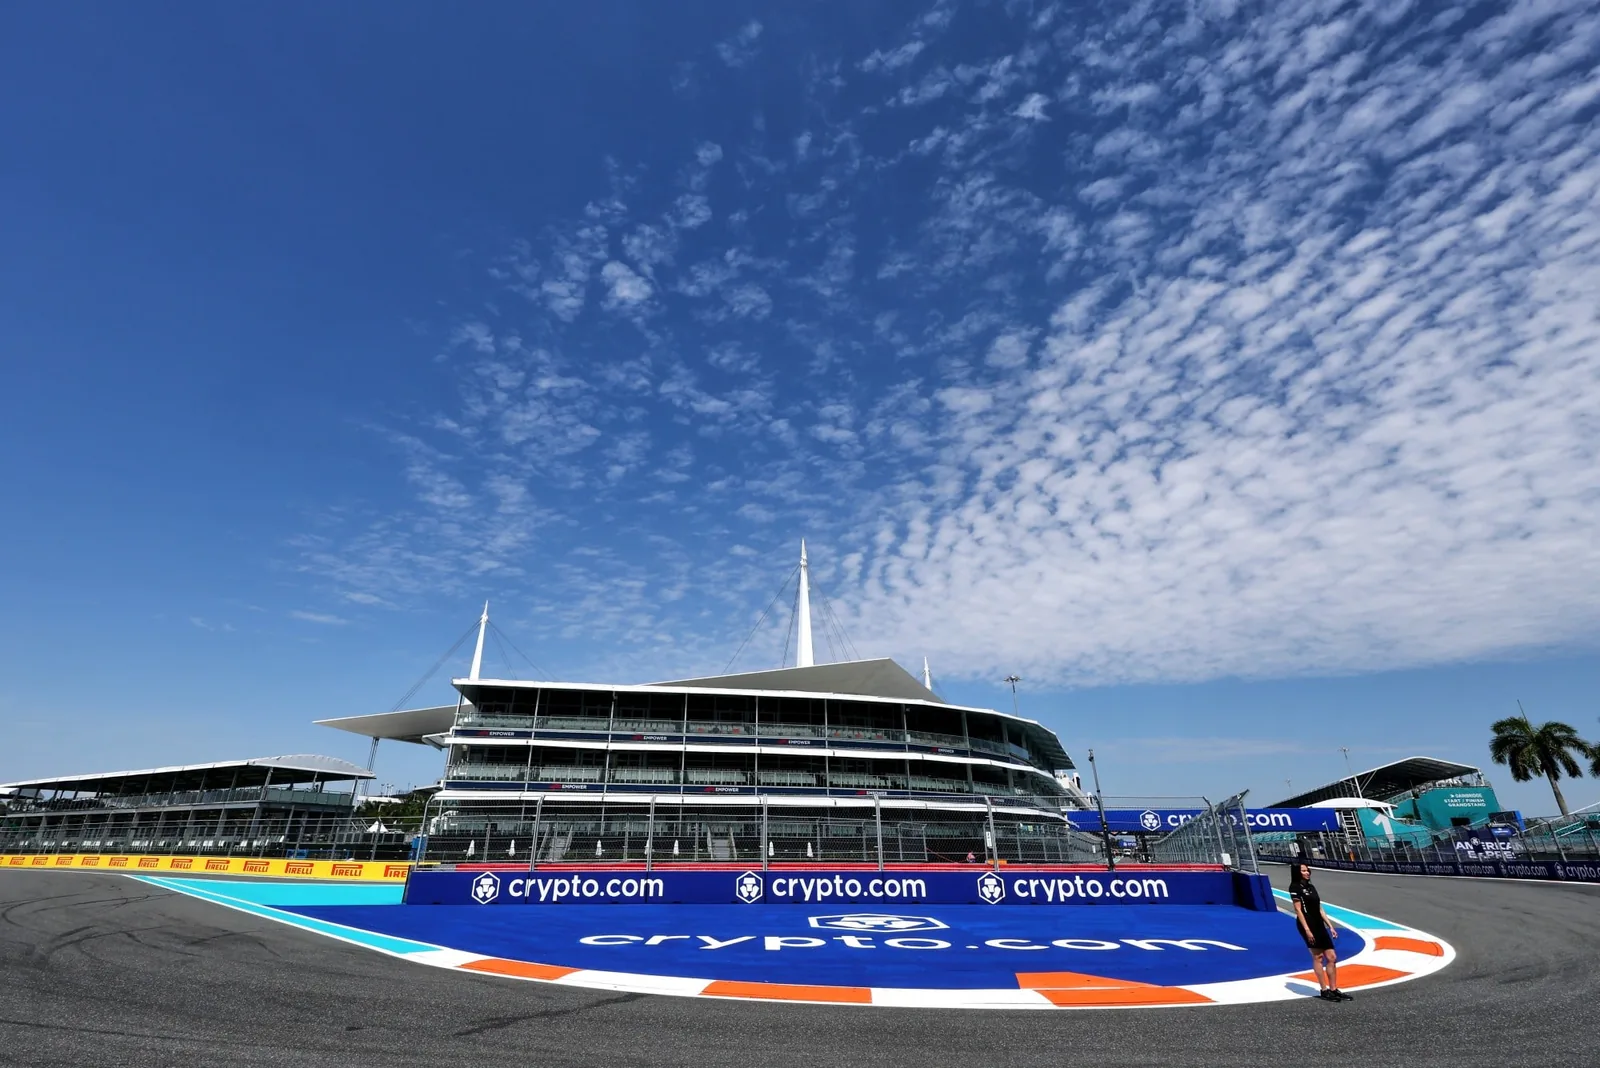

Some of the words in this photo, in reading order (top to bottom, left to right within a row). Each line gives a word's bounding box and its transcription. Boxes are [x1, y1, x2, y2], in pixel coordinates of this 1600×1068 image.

[1372, 814, 1396, 842] 1
[81, 857, 100, 866] PIRELLI
[109, 857, 128, 866] PIRELLI
[138, 858, 159, 867] PIRELLI
[170, 858, 193, 869] PIRELLI
[205, 859, 230, 870] PIRELLI
[243, 861, 270, 872] PIRELLI
[285, 862, 314, 874] PIRELLI
[331, 864, 363, 876] PIRELLI
[384, 865, 408, 878] PIRE
[1463, 864, 1496, 875] crypto.com
[1507, 864, 1548, 877] crypto.com
[1565, 864, 1600, 880] crypto.
[509, 875, 663, 901] crypto.com
[773, 875, 926, 901] crypto.com
[1014, 876, 1168, 901] crypto.com
[580, 934, 1248, 951] crypto.com
